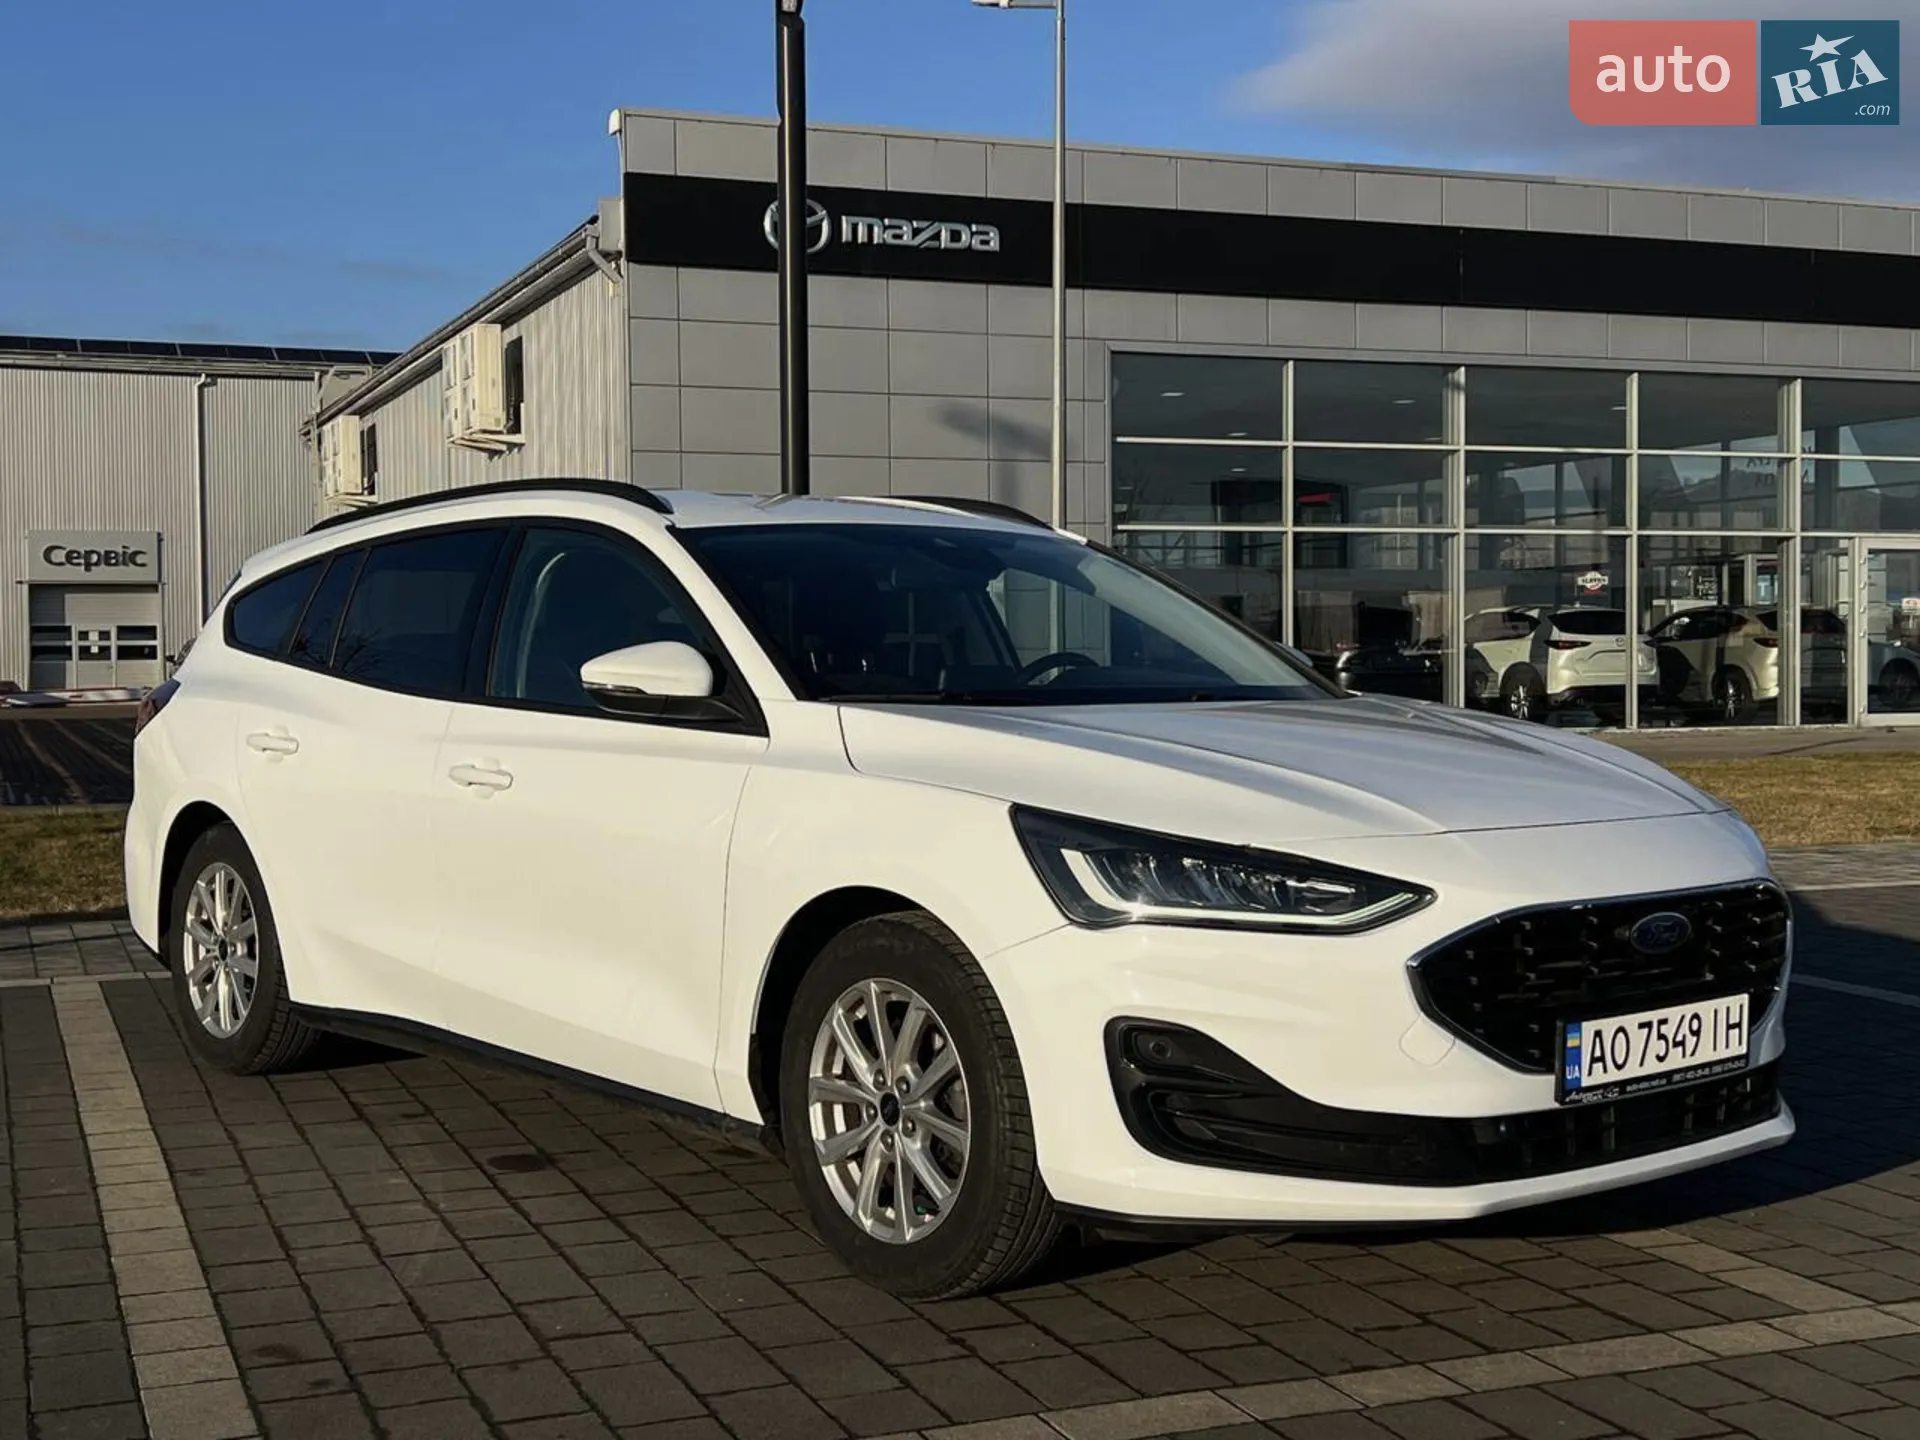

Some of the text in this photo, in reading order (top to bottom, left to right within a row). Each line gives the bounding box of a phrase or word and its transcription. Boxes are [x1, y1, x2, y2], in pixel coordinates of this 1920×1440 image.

[841, 215, 1000, 252] mazda
[43, 545, 148, 572] Сервіс
[1638, 1012, 1702, 1067] 7549
[1566, 1066, 1580, 1081] UA
